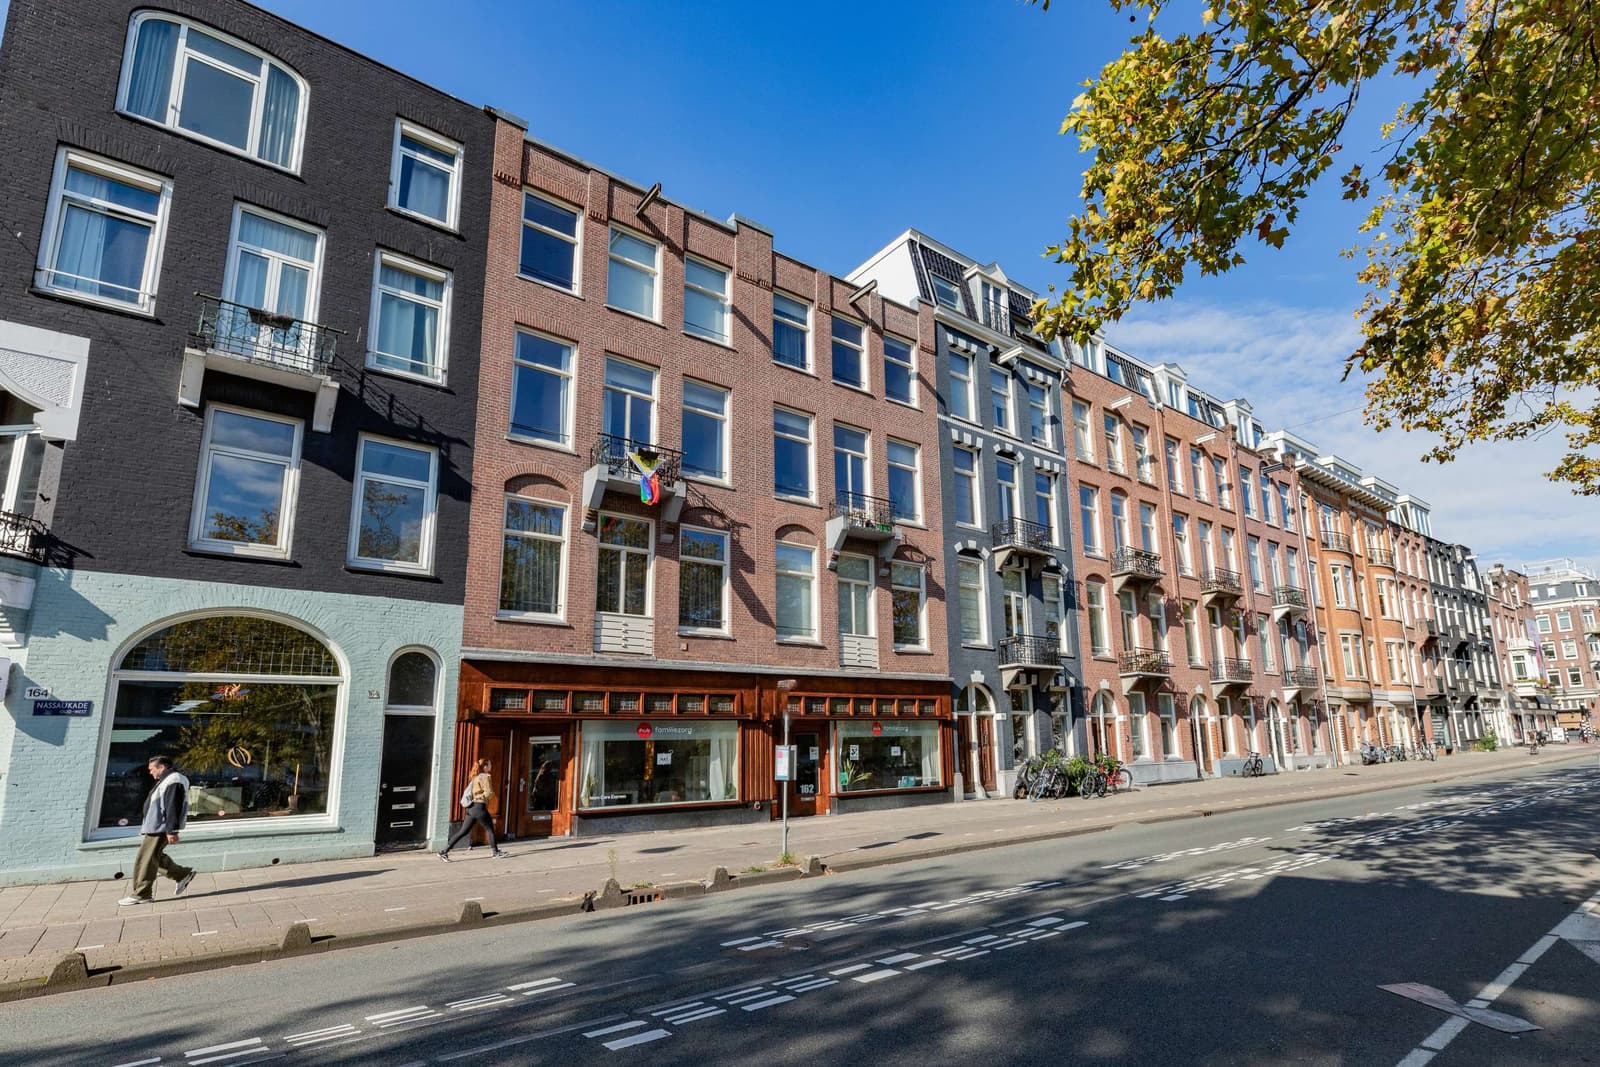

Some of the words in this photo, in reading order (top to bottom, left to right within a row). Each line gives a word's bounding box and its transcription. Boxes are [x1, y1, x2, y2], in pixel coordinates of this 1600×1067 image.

[27, 688, 49, 697] 164
[655, 726, 693, 735] familiezorg
[799, 784, 815, 794] 162
